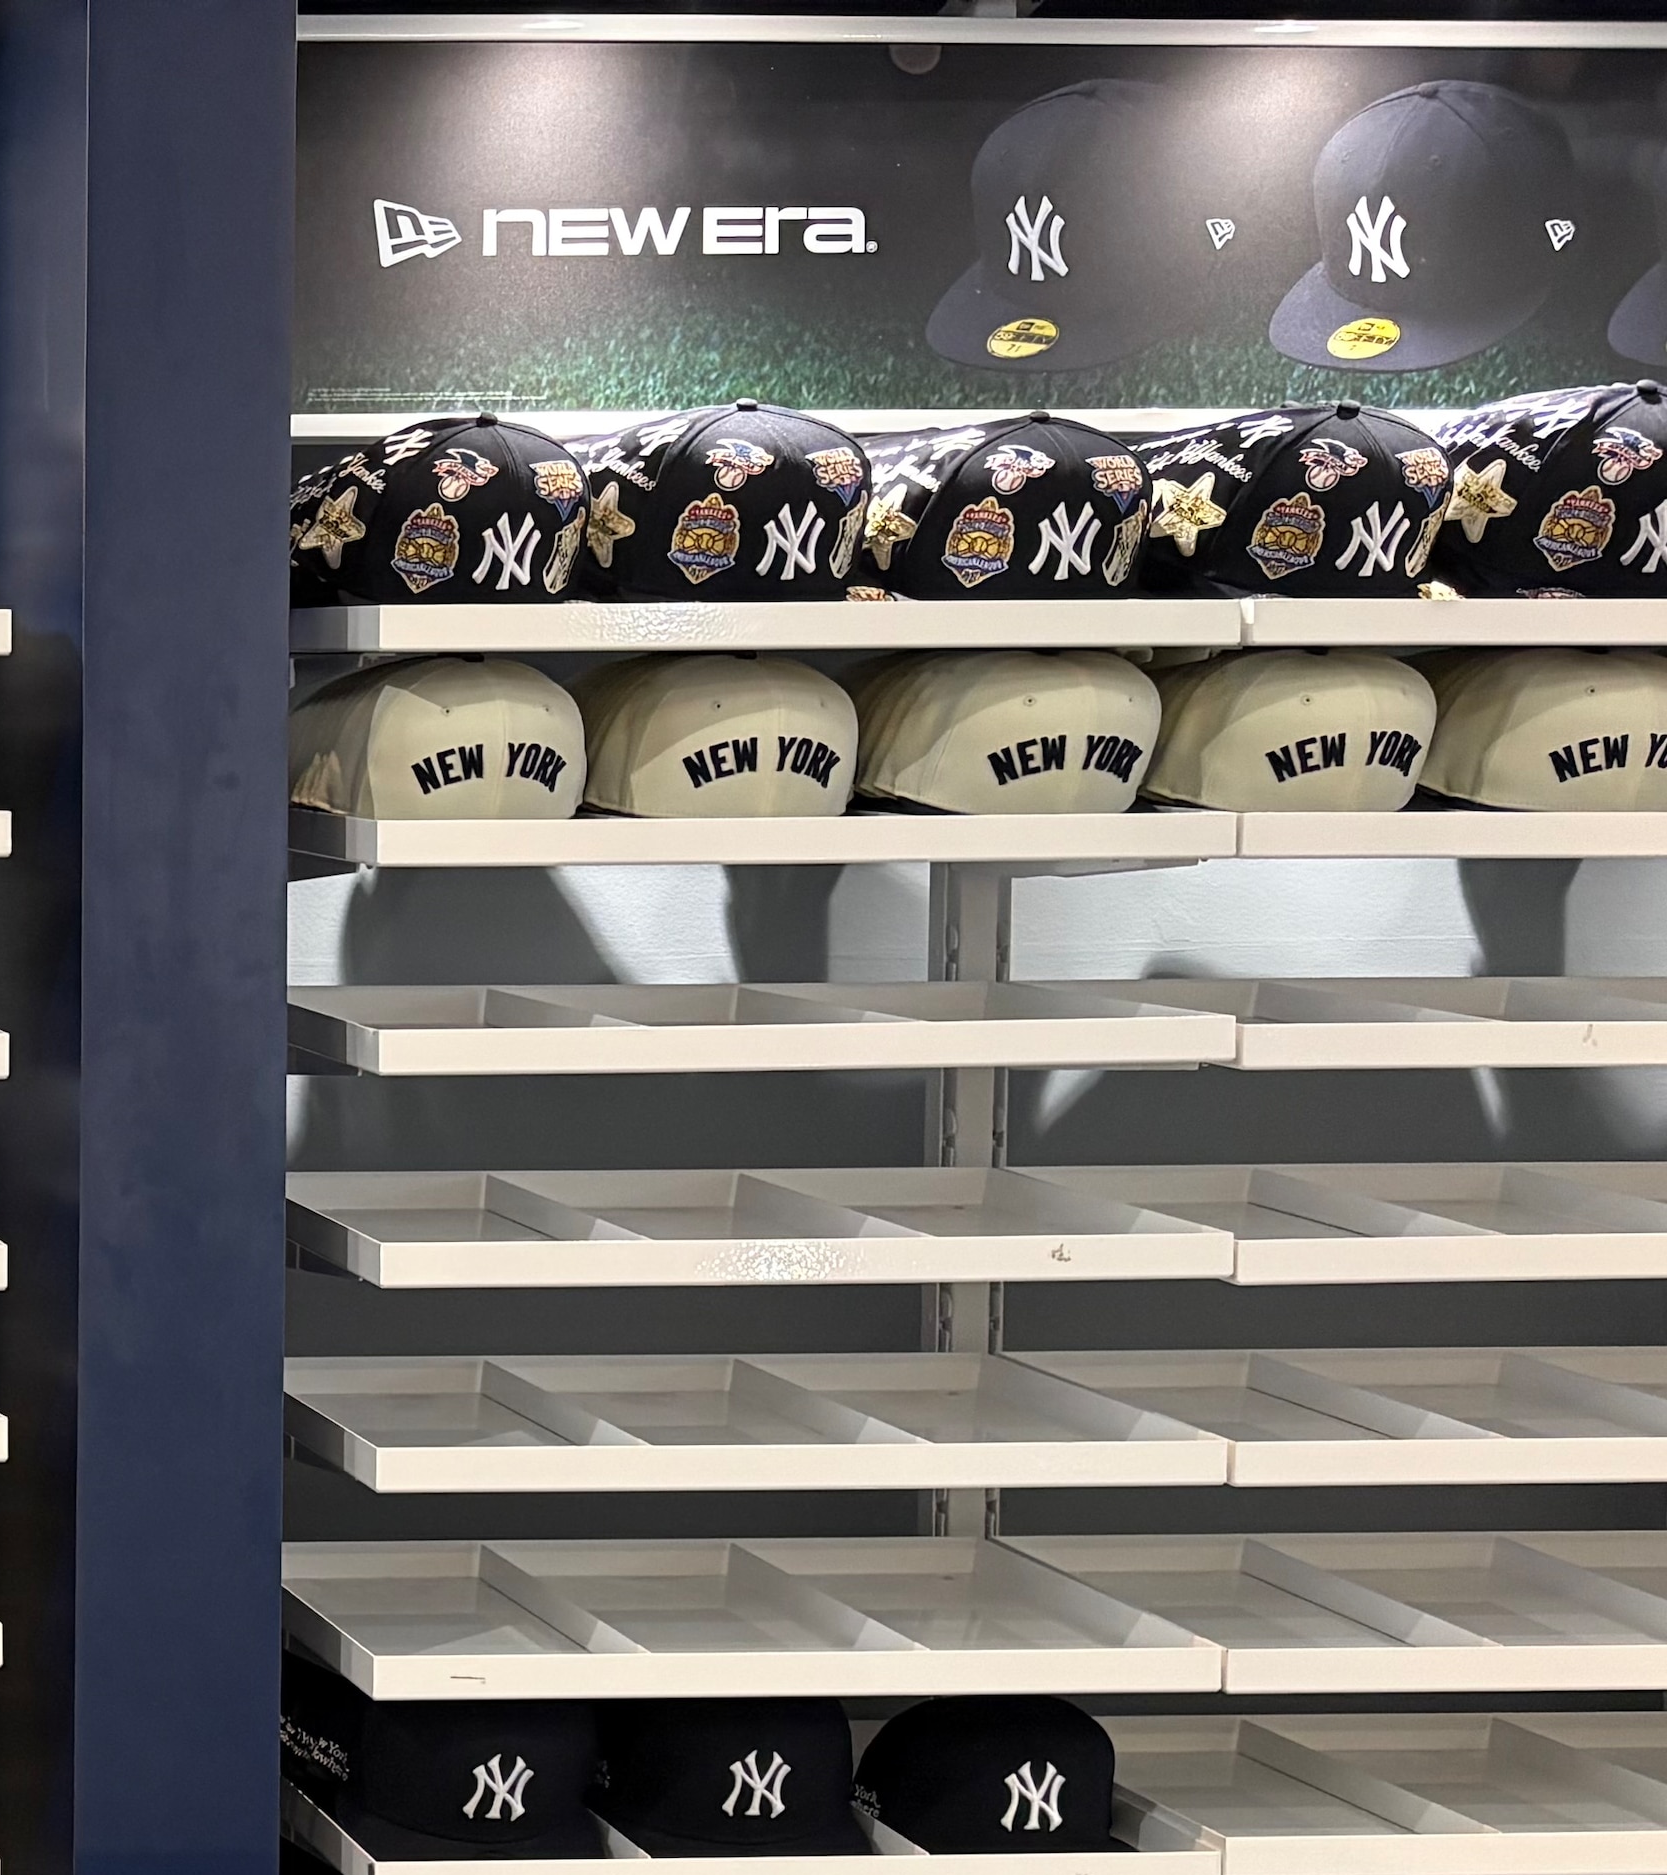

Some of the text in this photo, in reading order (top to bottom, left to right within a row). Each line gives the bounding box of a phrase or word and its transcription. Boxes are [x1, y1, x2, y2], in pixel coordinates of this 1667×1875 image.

[1005, 195, 1069, 283] NY
[1347, 195, 1410, 284] NY
[1090, 456, 1135, 469] WORLD
[1095, 468, 1142, 488] SERIES
[471, 512, 542, 591] NY
[755, 501, 825, 581] NY
[1335, 500, 1411, 577] NY
[411, 741, 567, 794] NEW YORK
[682, 734, 841, 790] NEW YORK
[987, 734, 1144, 786] NEW YORK
[1548, 733, 1630, 783] NEW
[721, 1749, 791, 1819] NY
